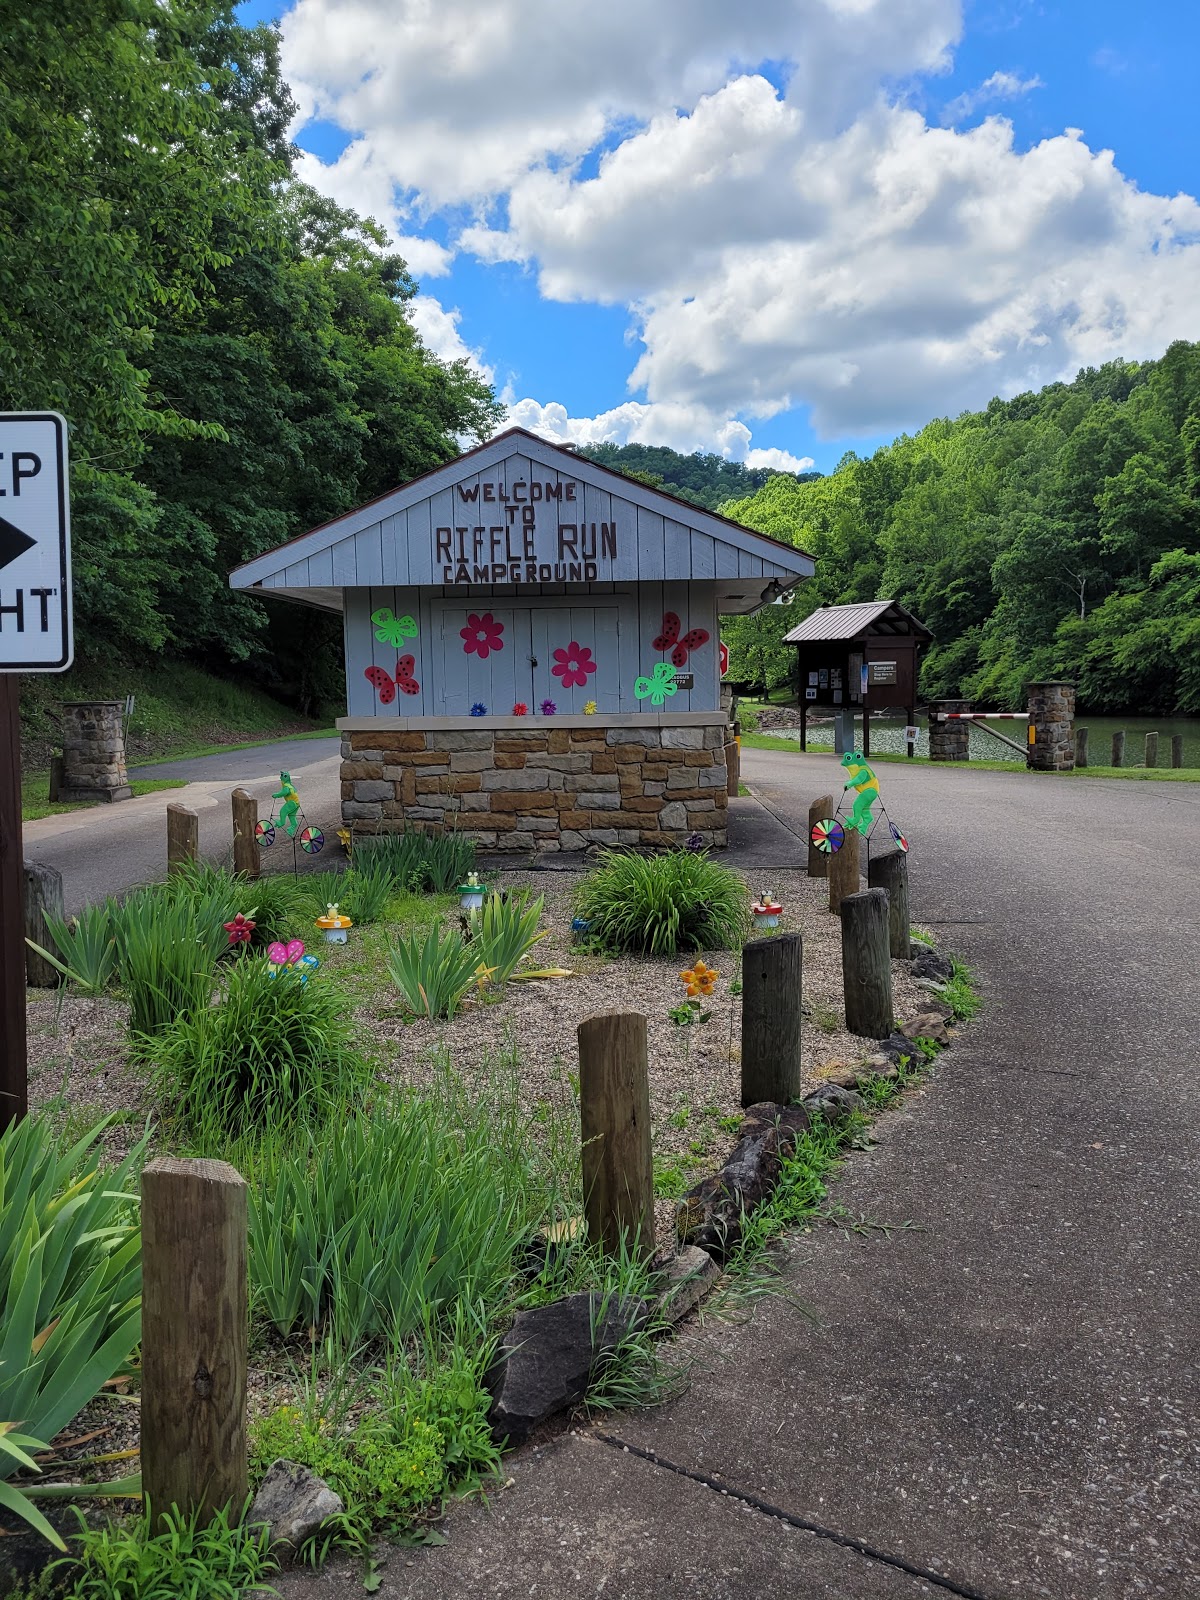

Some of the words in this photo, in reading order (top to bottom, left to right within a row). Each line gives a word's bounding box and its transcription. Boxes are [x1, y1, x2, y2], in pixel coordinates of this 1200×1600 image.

[0, 452, 42, 497] P
[457, 482, 577, 503] WELCOME
[505, 505, 535, 524] TO
[436, 525, 538, 564] RIFFLE
[559, 522, 617, 560] RUN
[443, 562, 598, 584] CAMPGROUND
